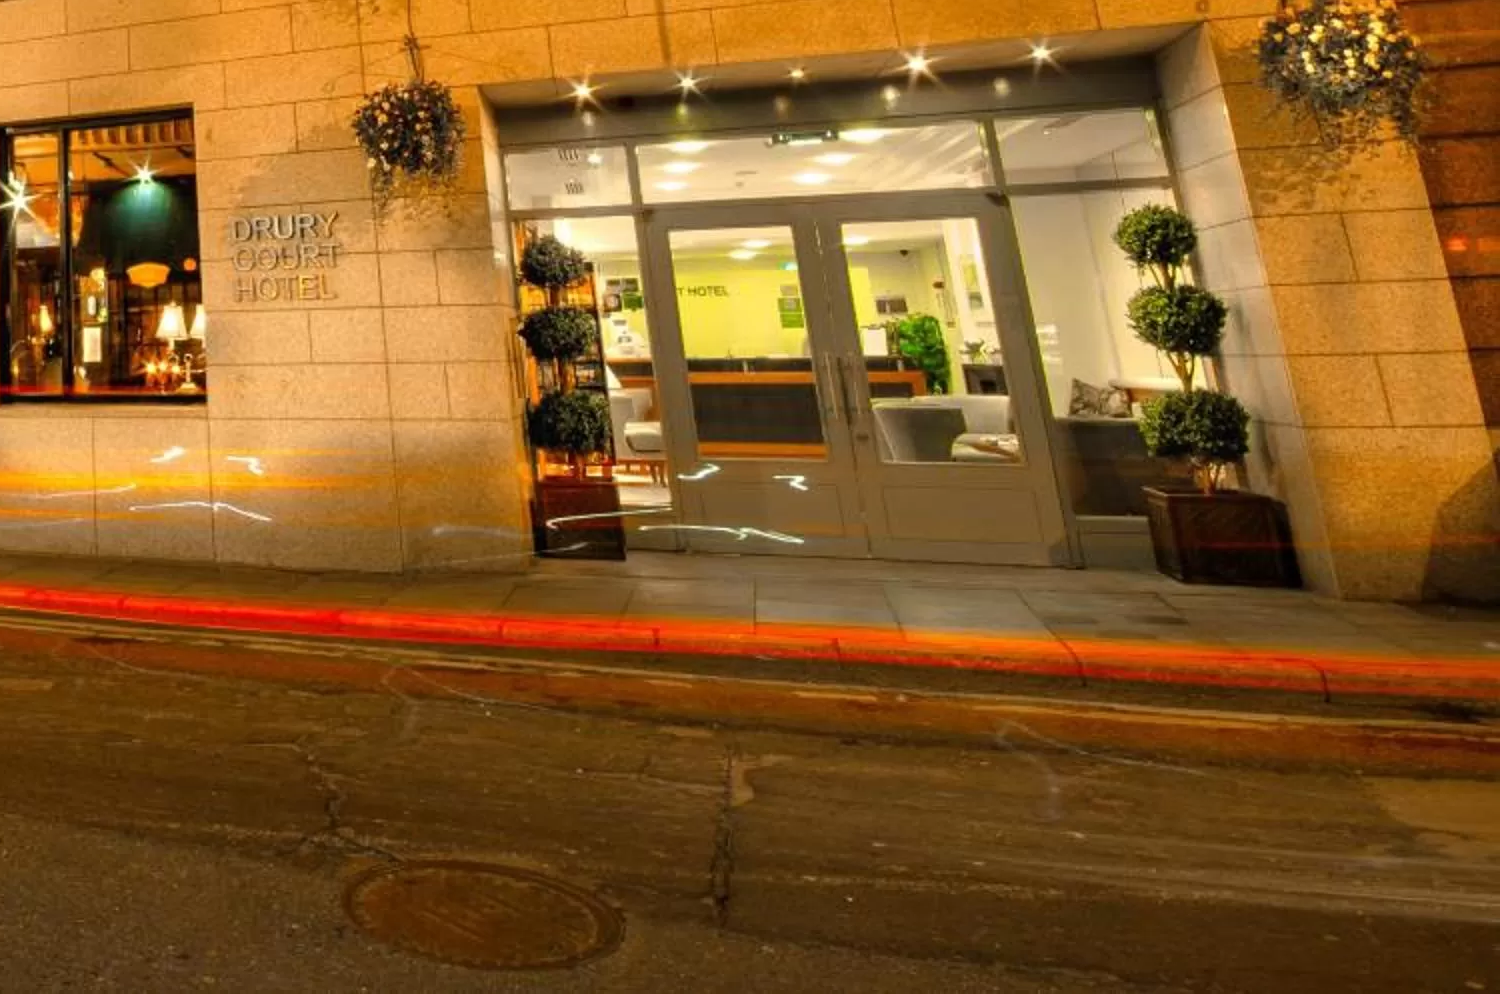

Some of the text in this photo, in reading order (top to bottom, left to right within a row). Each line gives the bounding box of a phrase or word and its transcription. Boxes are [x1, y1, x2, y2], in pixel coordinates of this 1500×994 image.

[232, 211, 340, 242] DRURY
[233, 243, 342, 272] COURT
[235, 273, 339, 303] HOTEL
